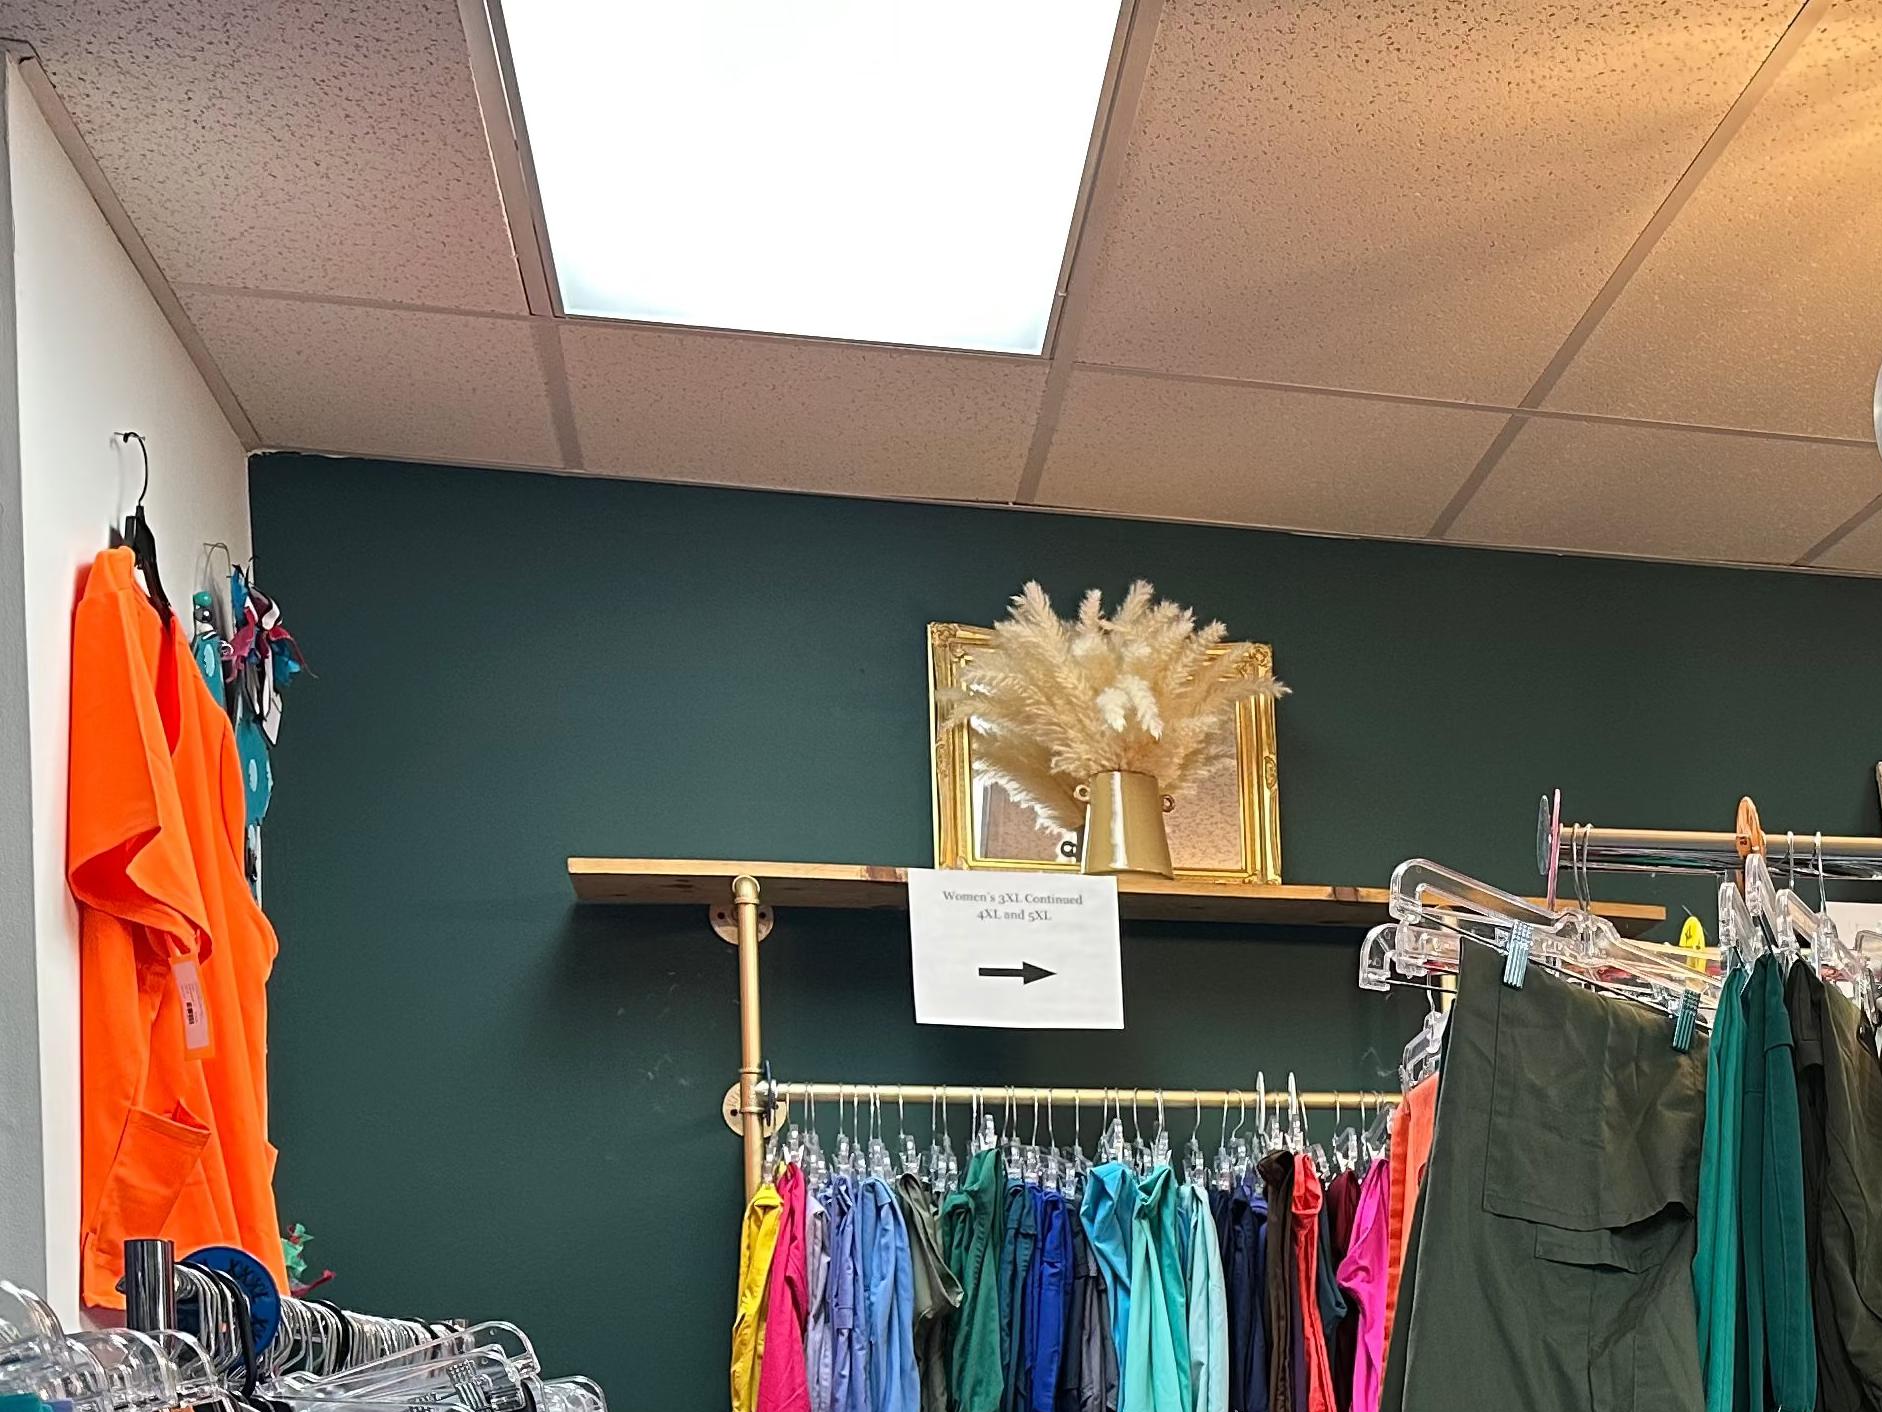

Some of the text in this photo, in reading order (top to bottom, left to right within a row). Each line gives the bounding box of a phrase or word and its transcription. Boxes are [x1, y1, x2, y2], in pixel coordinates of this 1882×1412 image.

[943, 890, 1083, 905] Women's 3XL Continued
[977, 909, 1052, 922] 4XL and 5XL
